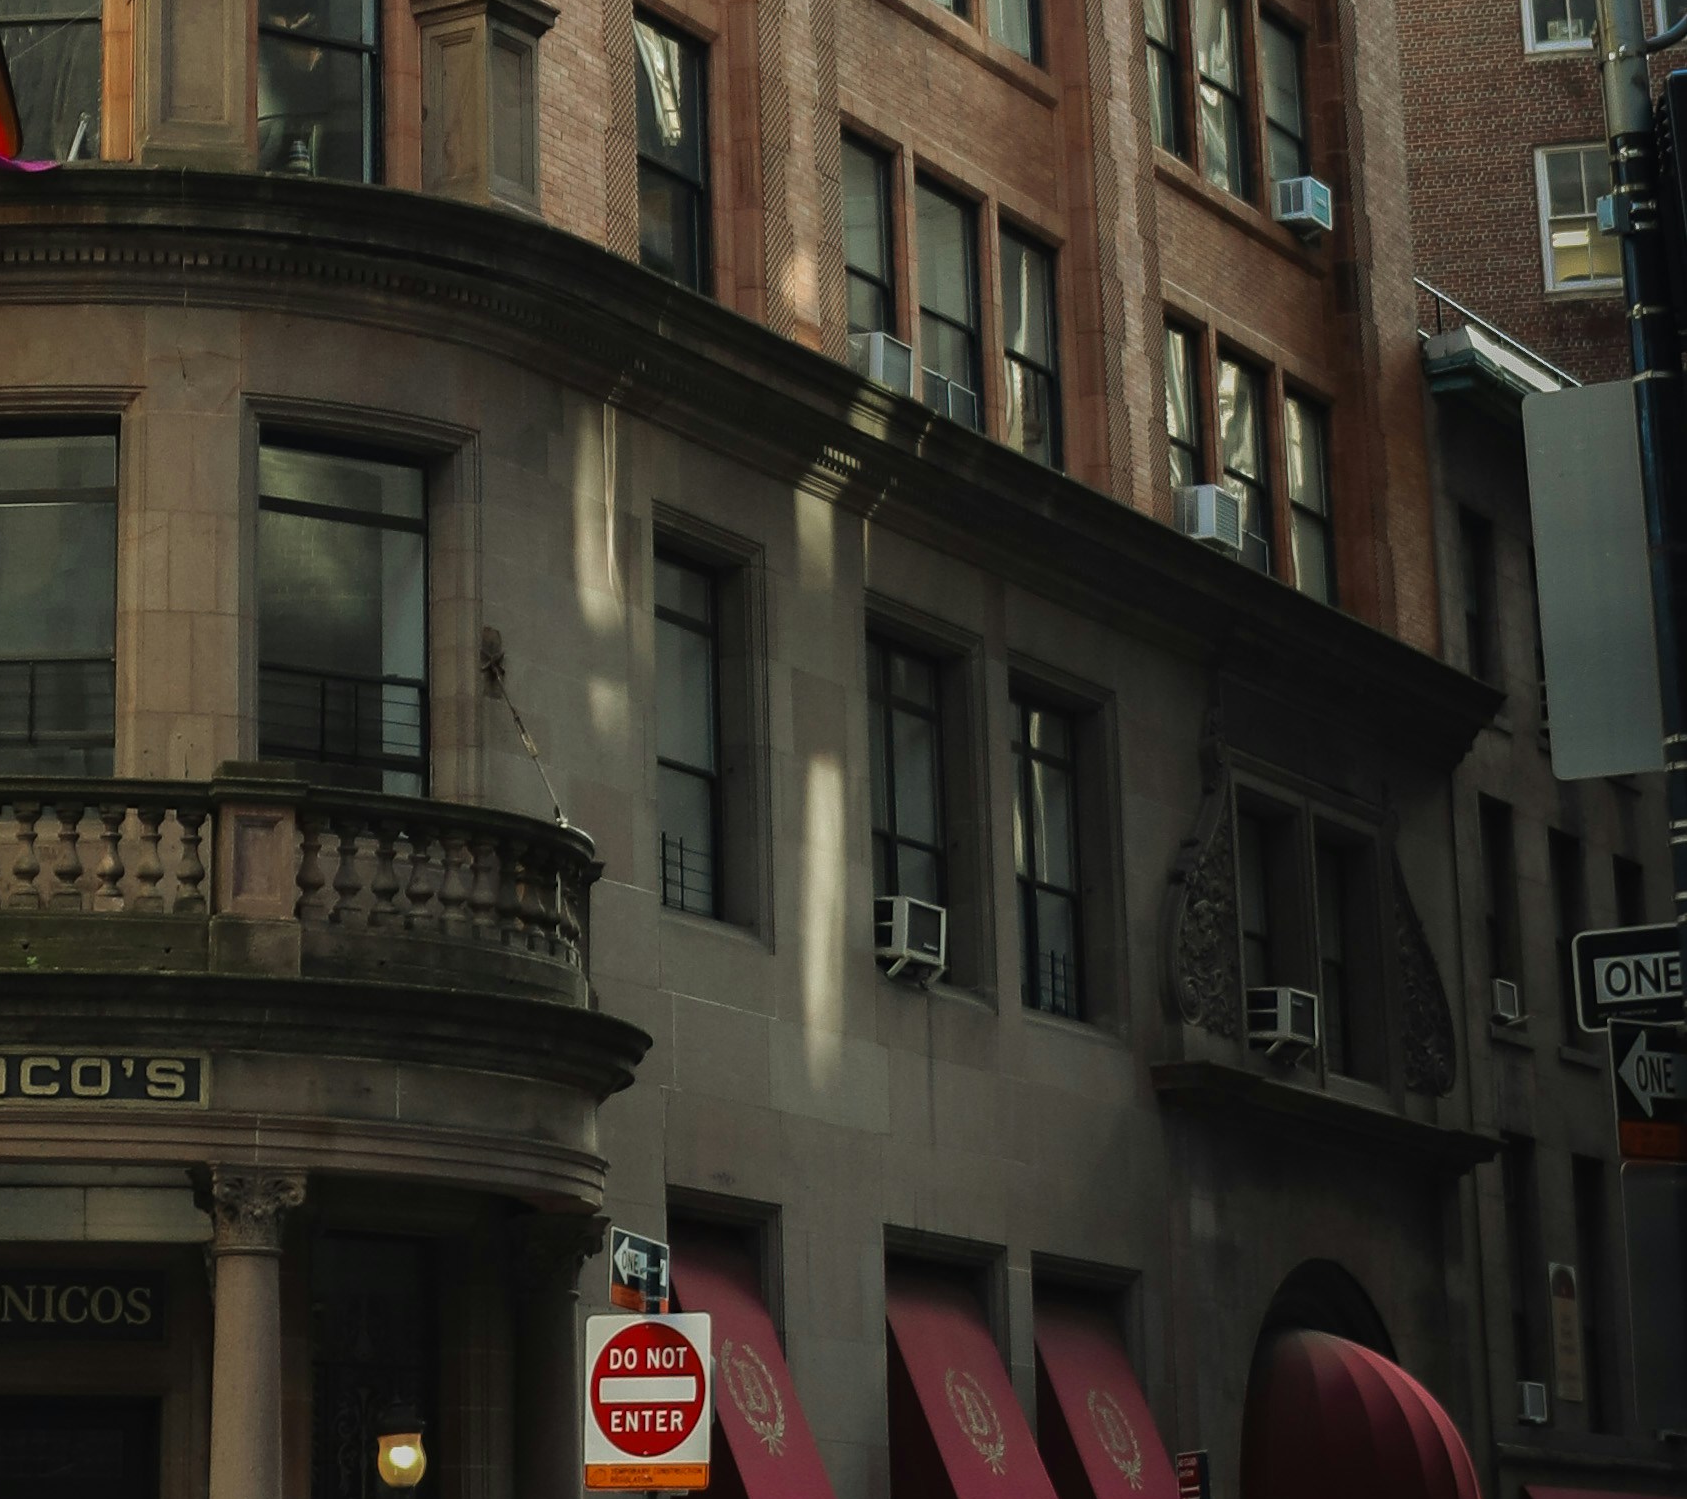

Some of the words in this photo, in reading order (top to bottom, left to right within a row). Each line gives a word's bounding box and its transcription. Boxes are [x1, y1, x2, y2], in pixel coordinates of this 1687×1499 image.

[1605, 956, 1682, 997] ONE
[1636, 1055, 1675, 1093] ONE
[622, 1251, 639, 1275] ONE
[609, 1347, 638, 1370] DO
[646, 1346, 688, 1370] NOT
[610, 1410, 684, 1433] ENTER
